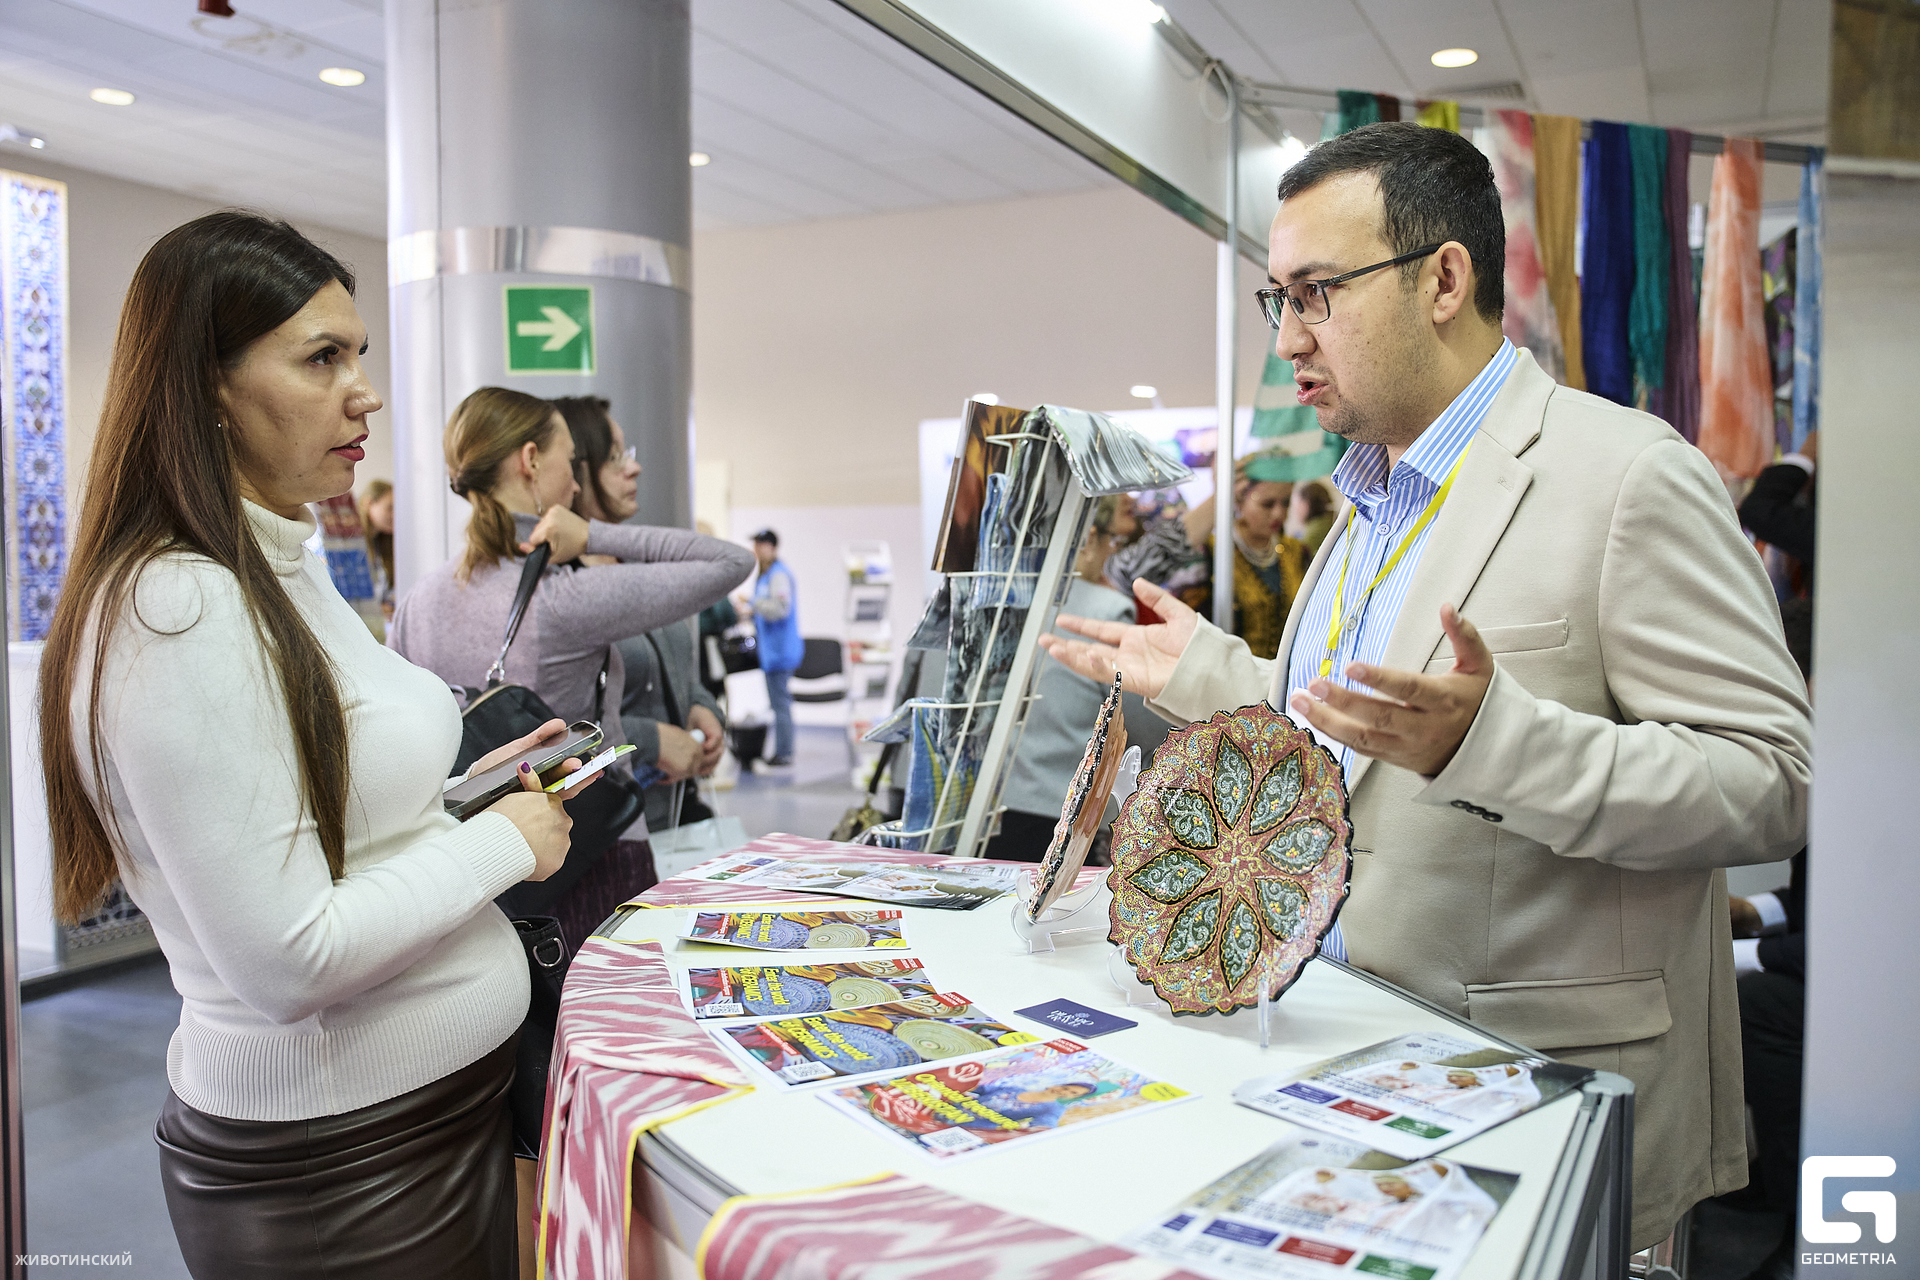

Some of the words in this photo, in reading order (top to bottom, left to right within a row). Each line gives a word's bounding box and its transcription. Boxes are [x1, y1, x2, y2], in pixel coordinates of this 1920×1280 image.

[741, 974, 763, 1001] CERAMICS
[764, 968, 780, 982] Enter
[771, 991, 790, 1005] world
[788, 1027, 838, 1059] CERAMICS
[803, 1016, 832, 1033] Enter
[823, 1032, 845, 1044] the
[838, 1042, 874, 1060] world
[915, 1073, 973, 1103] Oriental
